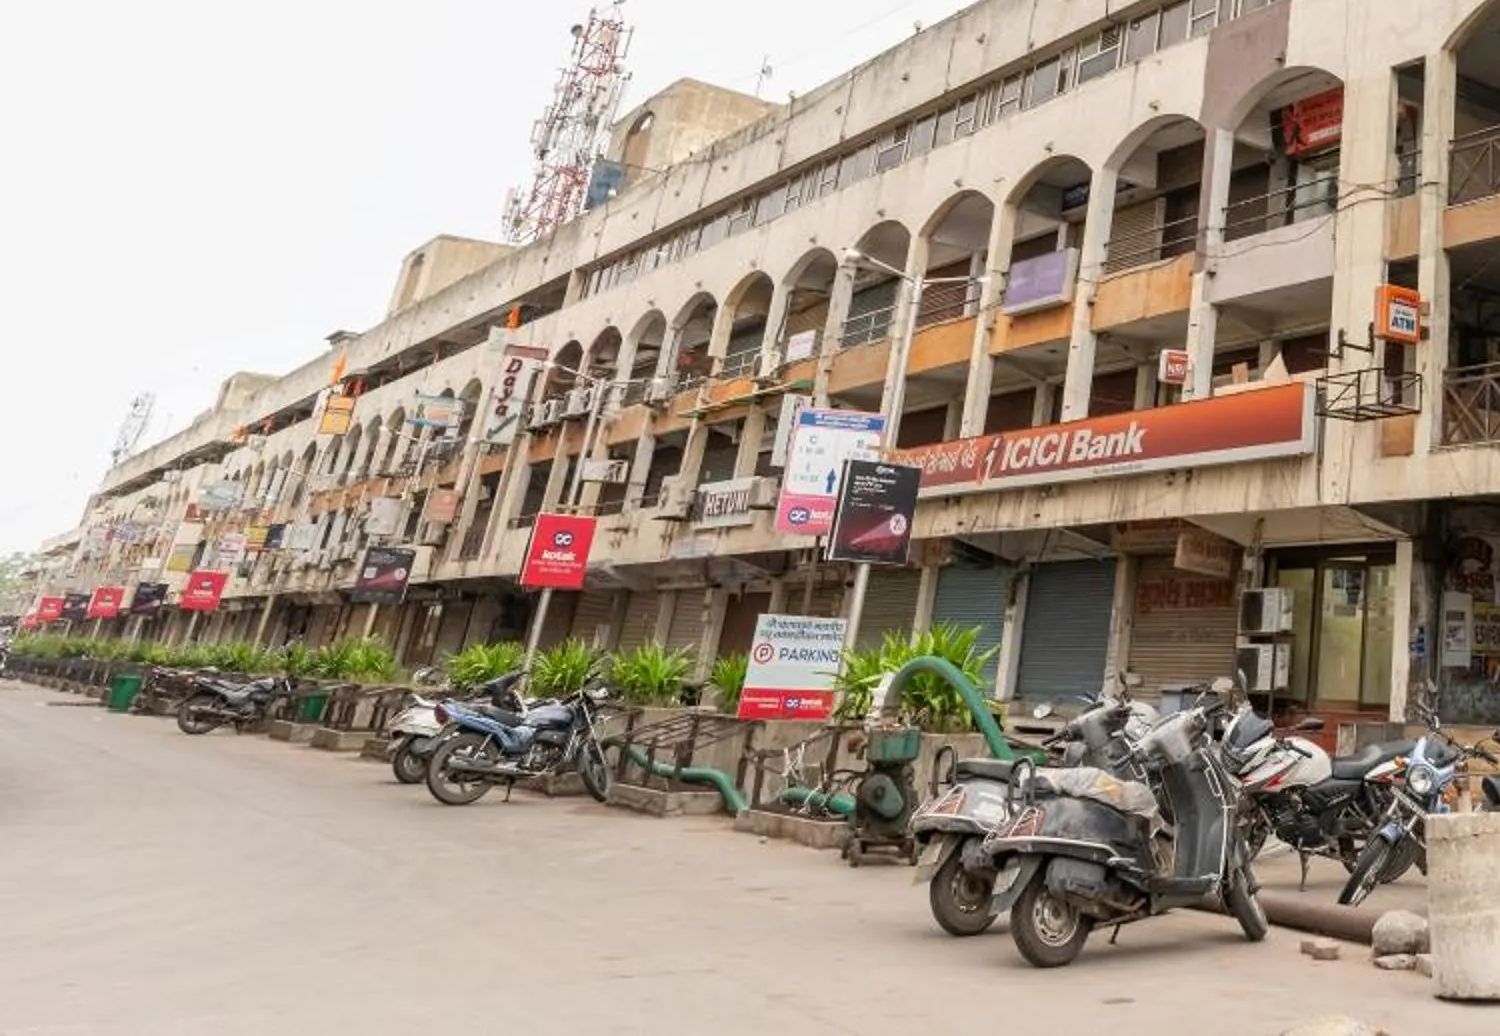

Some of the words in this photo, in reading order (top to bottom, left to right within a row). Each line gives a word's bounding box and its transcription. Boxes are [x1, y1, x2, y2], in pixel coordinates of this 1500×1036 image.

[1391, 315, 1415, 332] ATM
[1000, 430, 1069, 472] ICICI
[1068, 420, 1149, 463] Bank
[779, 647, 839, 663] PARKING
